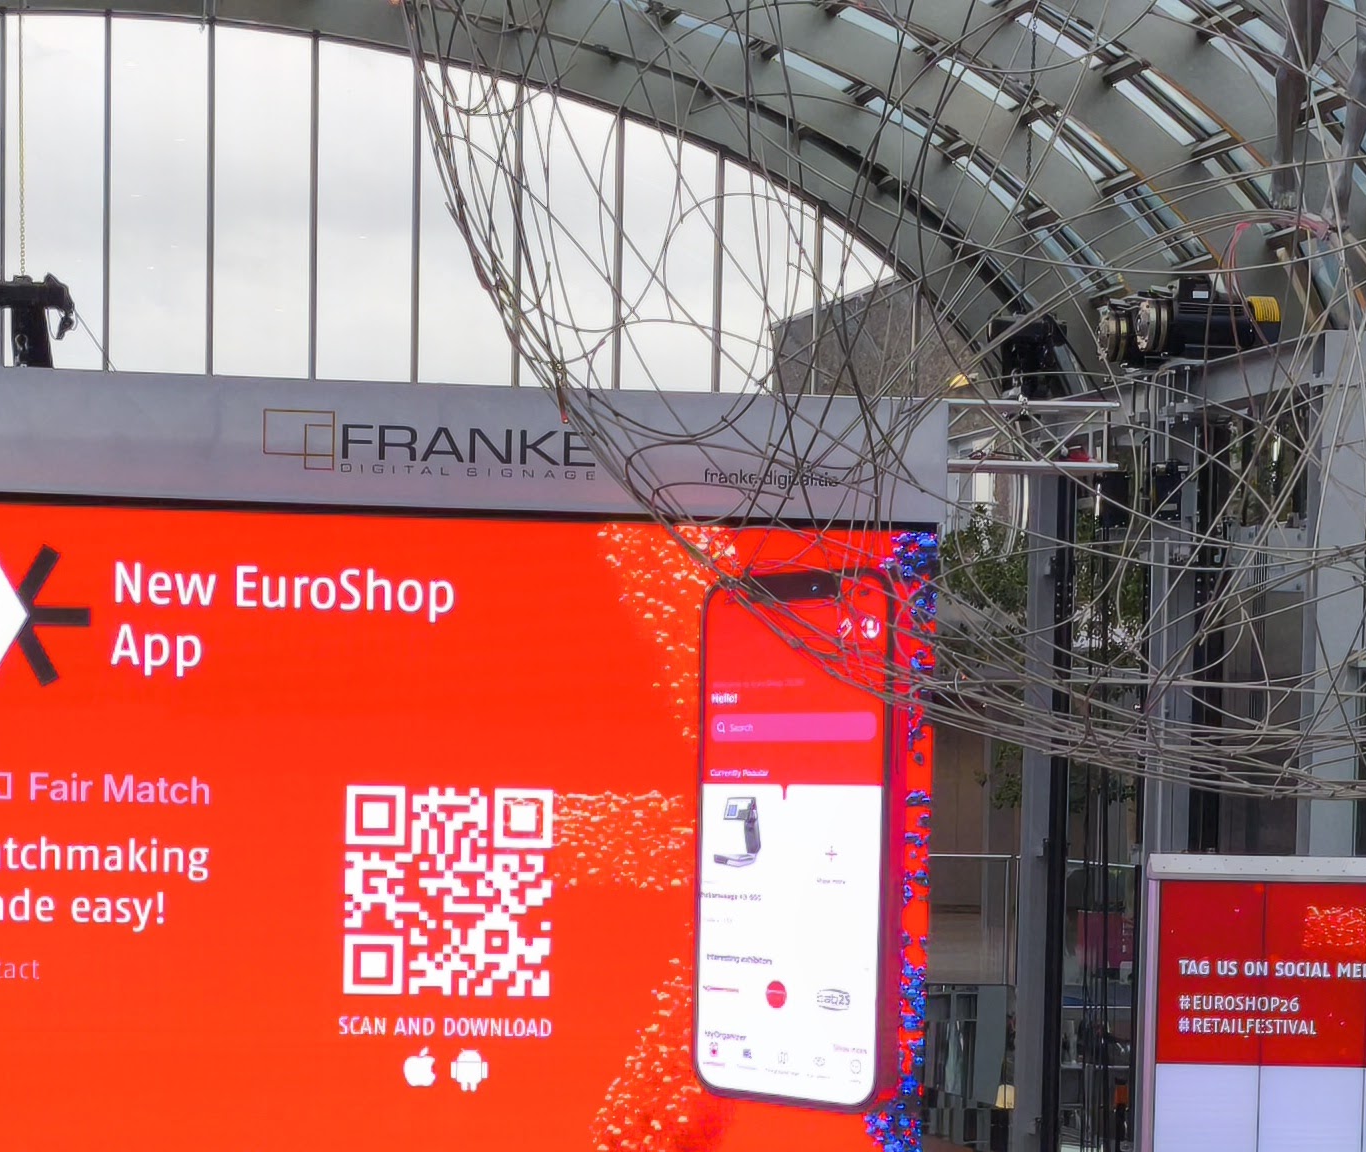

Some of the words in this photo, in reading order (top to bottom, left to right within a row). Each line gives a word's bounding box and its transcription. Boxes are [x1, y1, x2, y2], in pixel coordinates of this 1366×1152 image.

[341, 423, 596, 468] FRANKE
[340, 463, 450, 476] DIGITAL
[467, 466, 596, 481] SIGNAGE
[114, 561, 216, 607] New
[235, 565, 455, 623] EuroShop
[110, 624, 202, 677] App
[28, 771, 93, 802] Fair
[103, 772, 211, 805] Match
[70, 891, 166, 932] easy!
[1178, 959, 1210, 976] TAG
[1217, 960, 1238, 976] US
[1244, 961, 1268, 976] ON
[1275, 961, 1332, 978] SOCIAL
[1179, 995, 1300, 1012] #EUROSHOP26
[338, 1015, 387, 1035] SCAN
[393, 1017, 435, 1036] AND
[443, 1017, 552, 1037] DOWNLOAD
[1178, 1017, 1317, 1035] #RETAILFESTIVAL
